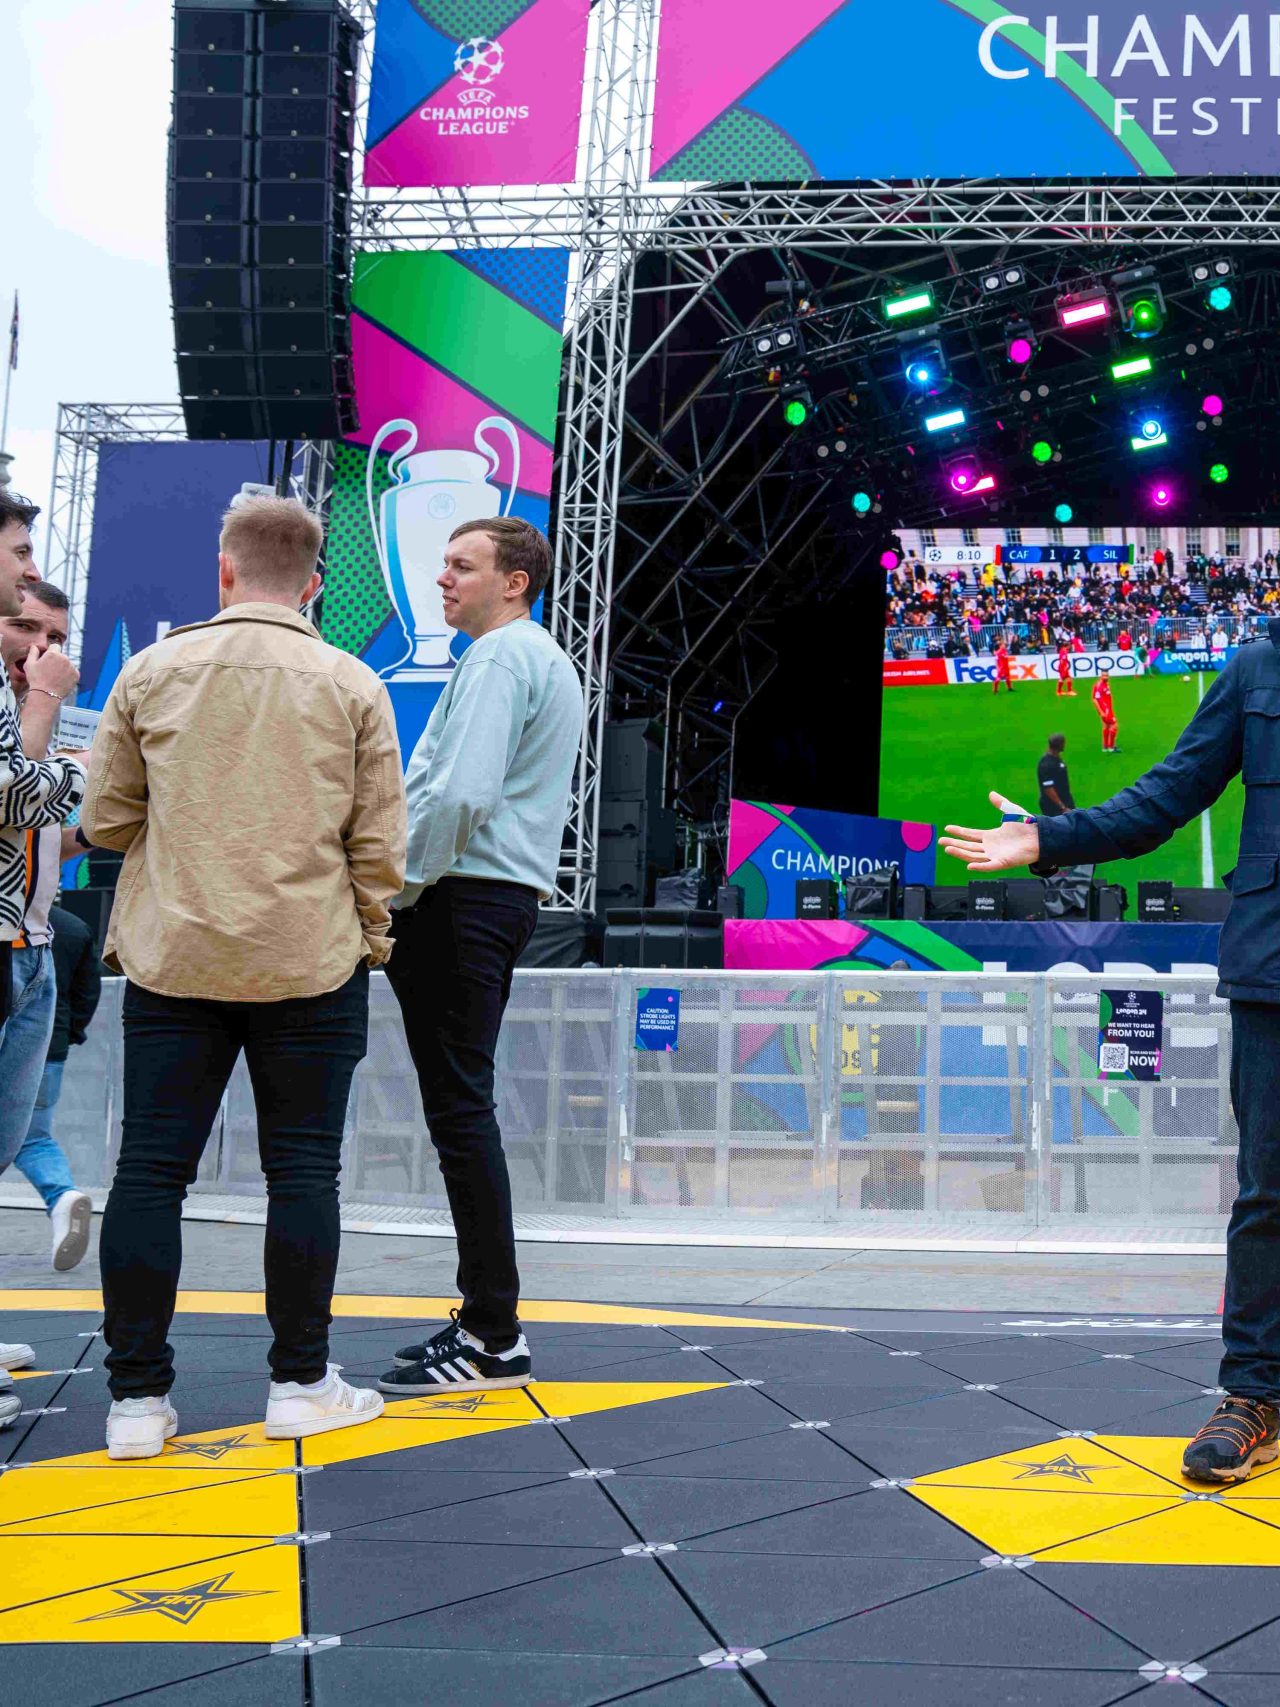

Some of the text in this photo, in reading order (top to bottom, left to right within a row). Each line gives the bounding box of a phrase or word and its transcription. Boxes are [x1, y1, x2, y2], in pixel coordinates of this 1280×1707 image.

[458, 89, 494, 105] UEFA
[420, 106, 529, 120] CHAMPIONS
[438, 121, 510, 135] LEAGUE
[957, 550, 981, 561] 8:10
[1009, 549, 1119, 560] CAF 1 2 SIL
[1210, 651, 1227, 662] 24
[1107, 1029, 1155, 1038] FROM YOU!
[1130, 1056, 1159, 1066] NOW
